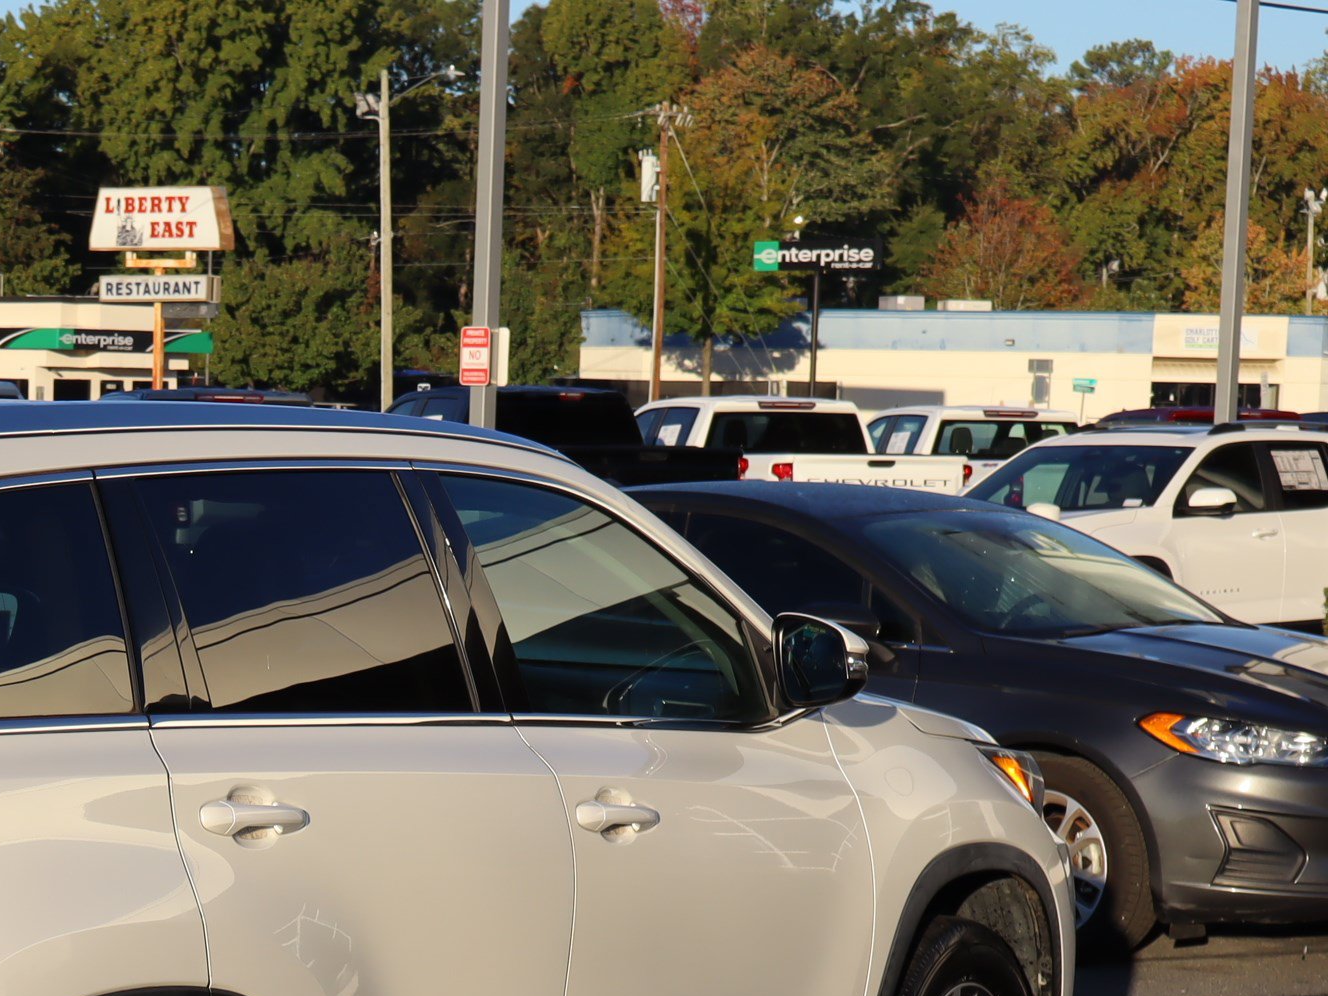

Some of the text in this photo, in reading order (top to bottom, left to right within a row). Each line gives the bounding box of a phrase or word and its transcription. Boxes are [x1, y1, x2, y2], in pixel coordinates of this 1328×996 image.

[105, 196, 190, 214] LIBERTY
[150, 221, 197, 238] EAST
[754, 244, 874, 266] enterprise
[106, 281, 200, 296] RESTAURANT
[59, 332, 134, 348] enterprise
[1185, 328, 1219, 336] CHARLOTT
[468, 350, 481, 361] NO
